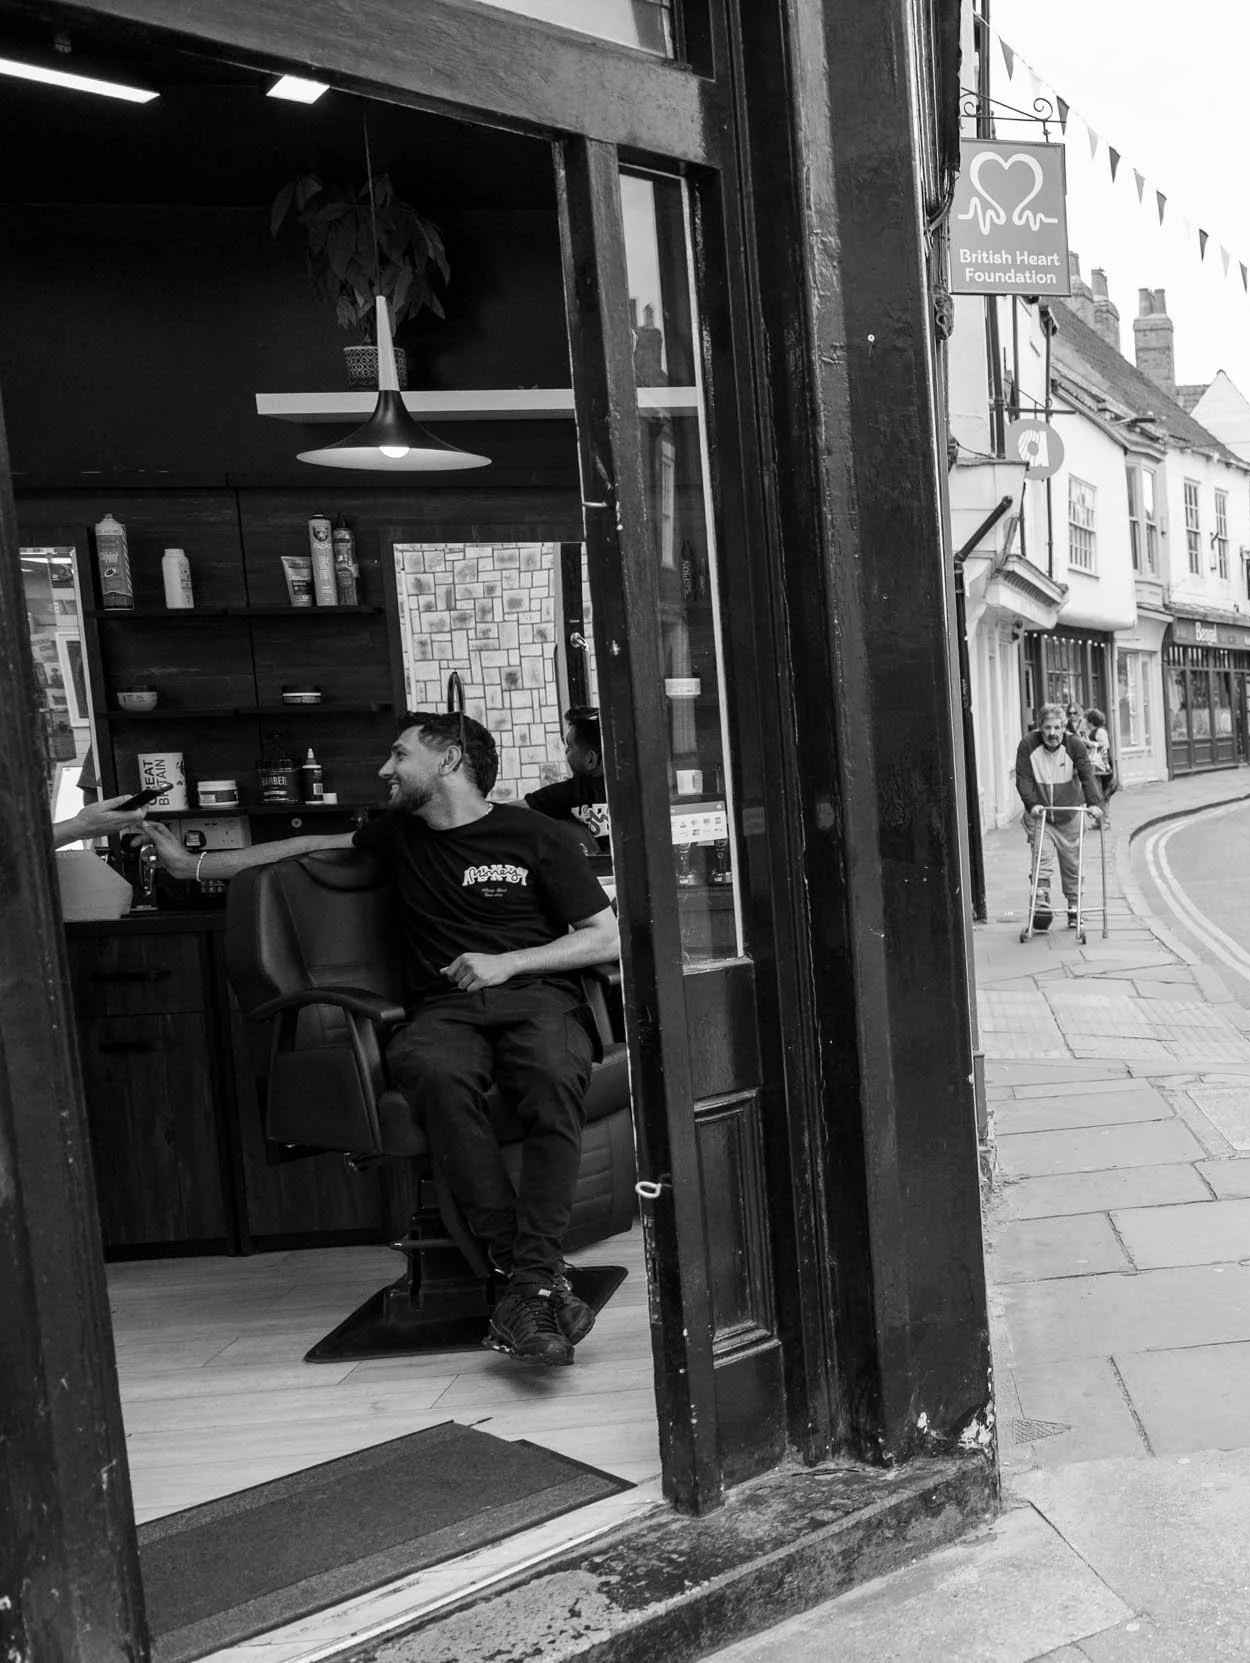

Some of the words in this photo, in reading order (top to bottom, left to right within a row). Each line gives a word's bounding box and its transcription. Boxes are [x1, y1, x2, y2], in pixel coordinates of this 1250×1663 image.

[960, 248, 1012, 265] British
[1016, 250, 1061, 266] Heart
[965, 267, 1057, 284] Foundation
